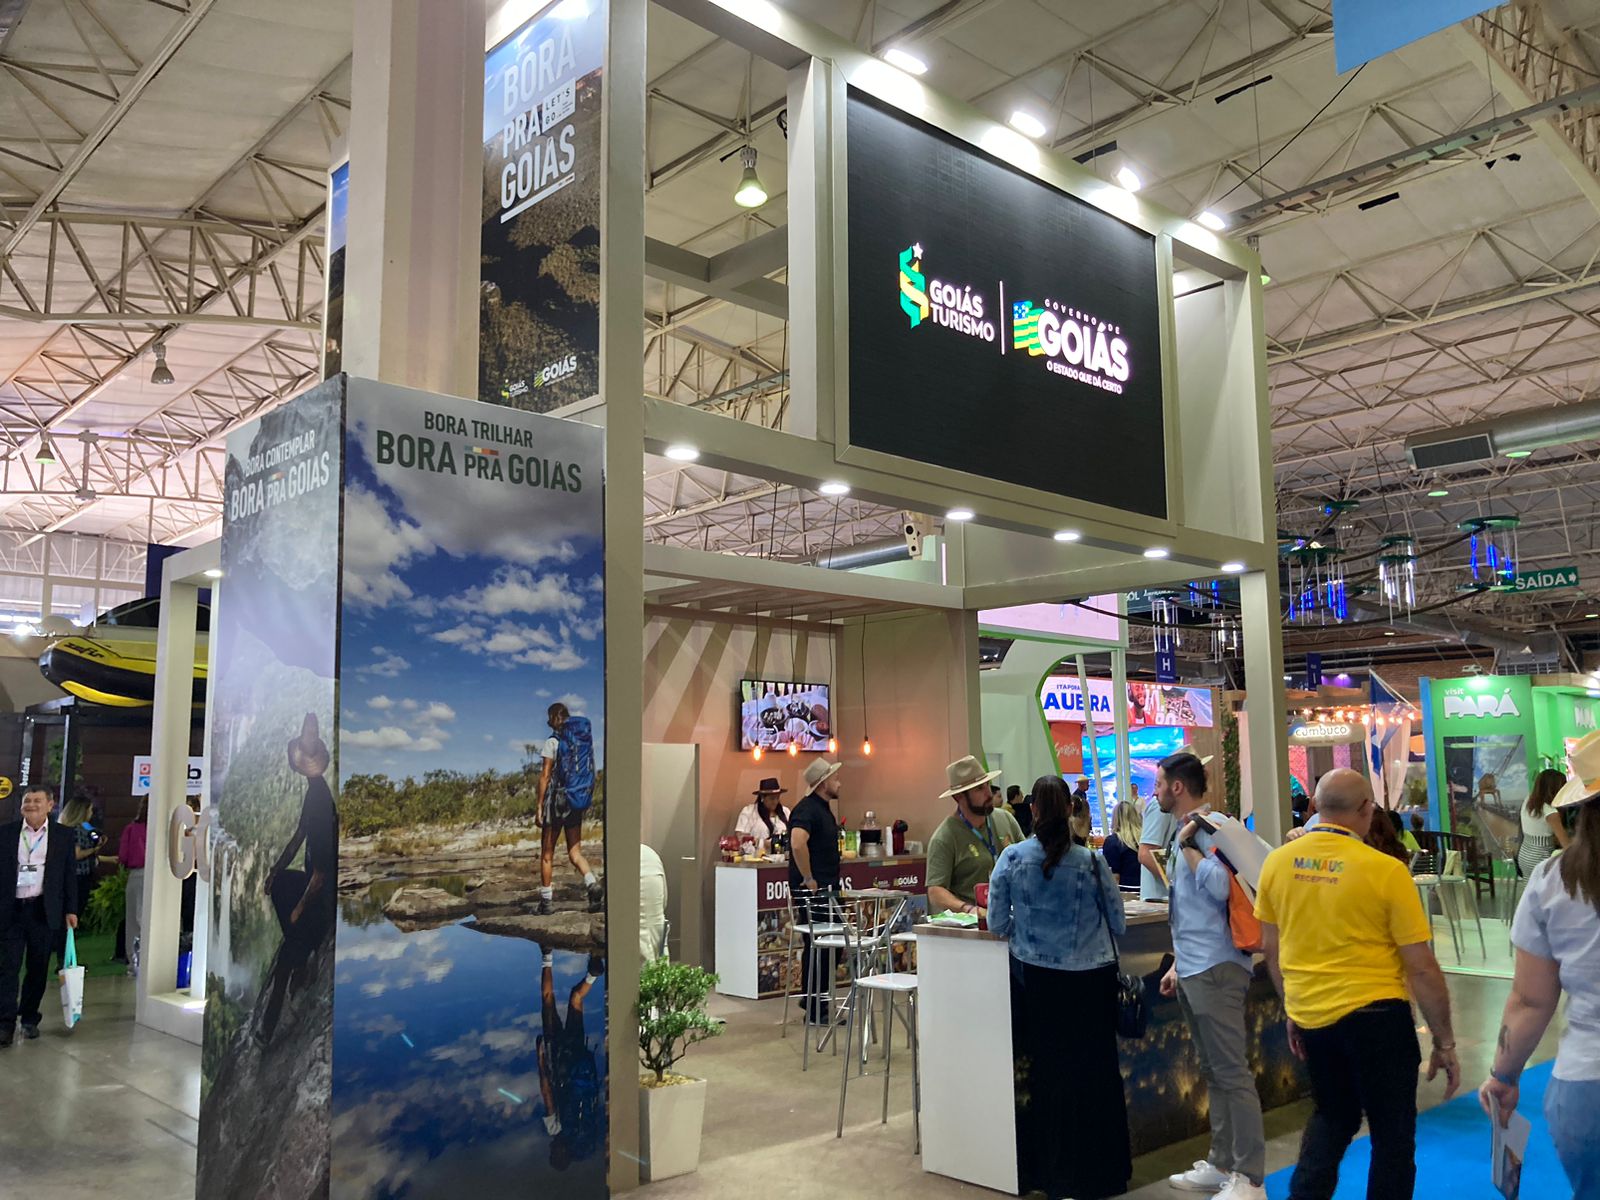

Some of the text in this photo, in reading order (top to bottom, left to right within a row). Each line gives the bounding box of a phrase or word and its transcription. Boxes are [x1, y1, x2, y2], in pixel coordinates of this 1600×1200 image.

[504, 26, 577, 116] BORA
[545, 87, 570, 111] LET'S
[503, 103, 541, 159] PRA
[929, 279, 984, 319] GOIÁS
[1044, 298, 1120, 335] GOVERNO DE
[930, 302, 995, 342] TURISMO
[1037, 310, 1129, 382] GOIÁS
[542, 355, 578, 382] GOIÁS
[1046, 360, 1053, 371] O
[1053, 362, 1079, 380] ESTADO
[1079, 371, 1093, 384] QUE
[1102, 379, 1123, 395] CERTO
[424, 411, 533, 449] BORA TRILHAR
[244, 429, 316, 478] BORA CONTEMPLAR
[376, 429, 457, 476] BORA
[463, 453, 504, 482] PRA
[230, 479, 265, 522] BORA
[267, 477, 287, 508] PRA
[1515, 572, 1567, 591] SAÍDA
[1162, 657, 1171, 672] H
[1043, 692, 1111, 713] AUERA
[1443, 687, 1521, 719] PARÁ
[1444, 688, 1465, 696] visit
[898, 875, 918, 885] GOIÁS
[1294, 857, 1344, 873] MANAUS
